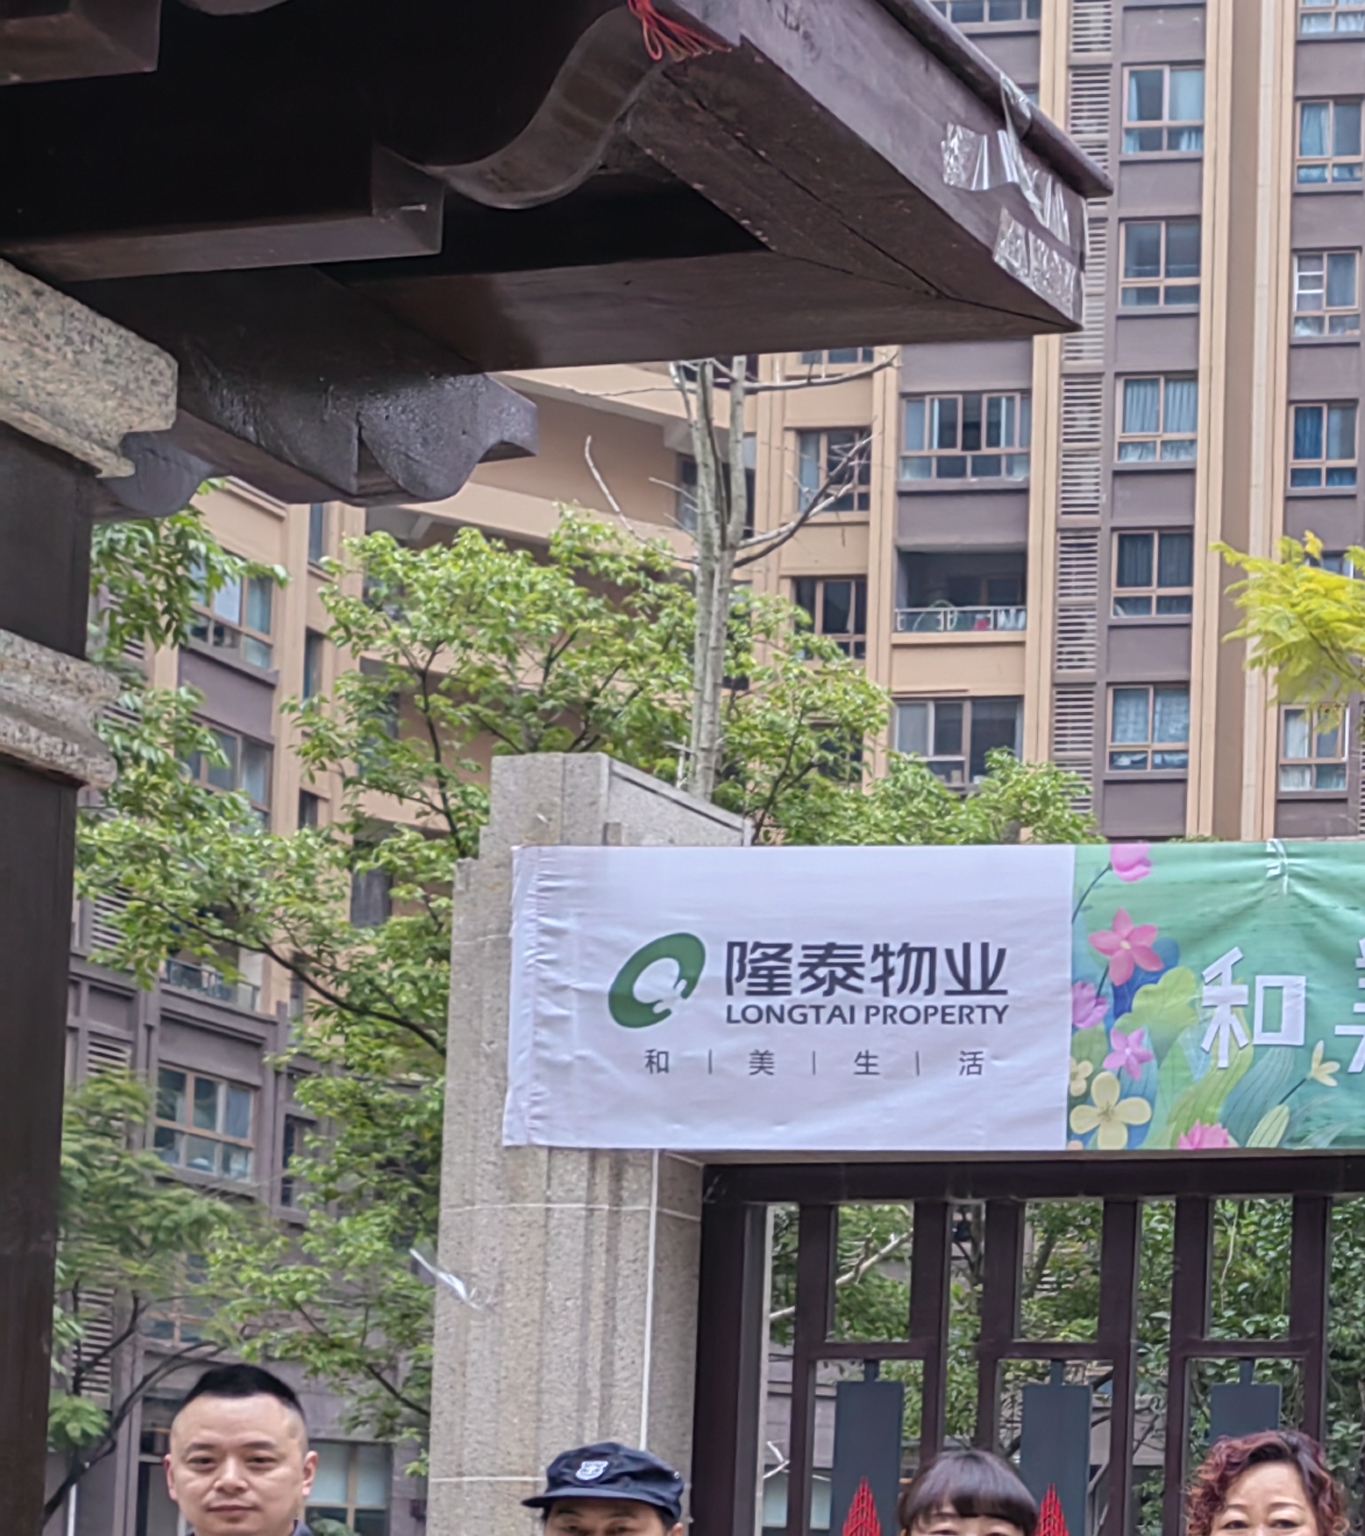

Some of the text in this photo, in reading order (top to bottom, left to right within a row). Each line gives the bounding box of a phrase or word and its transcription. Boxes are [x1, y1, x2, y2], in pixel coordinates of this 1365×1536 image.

[725, 940, 1009, 997] 隆泰物业
[726, 1004, 1010, 1026] LONGTAI PROPERTY
